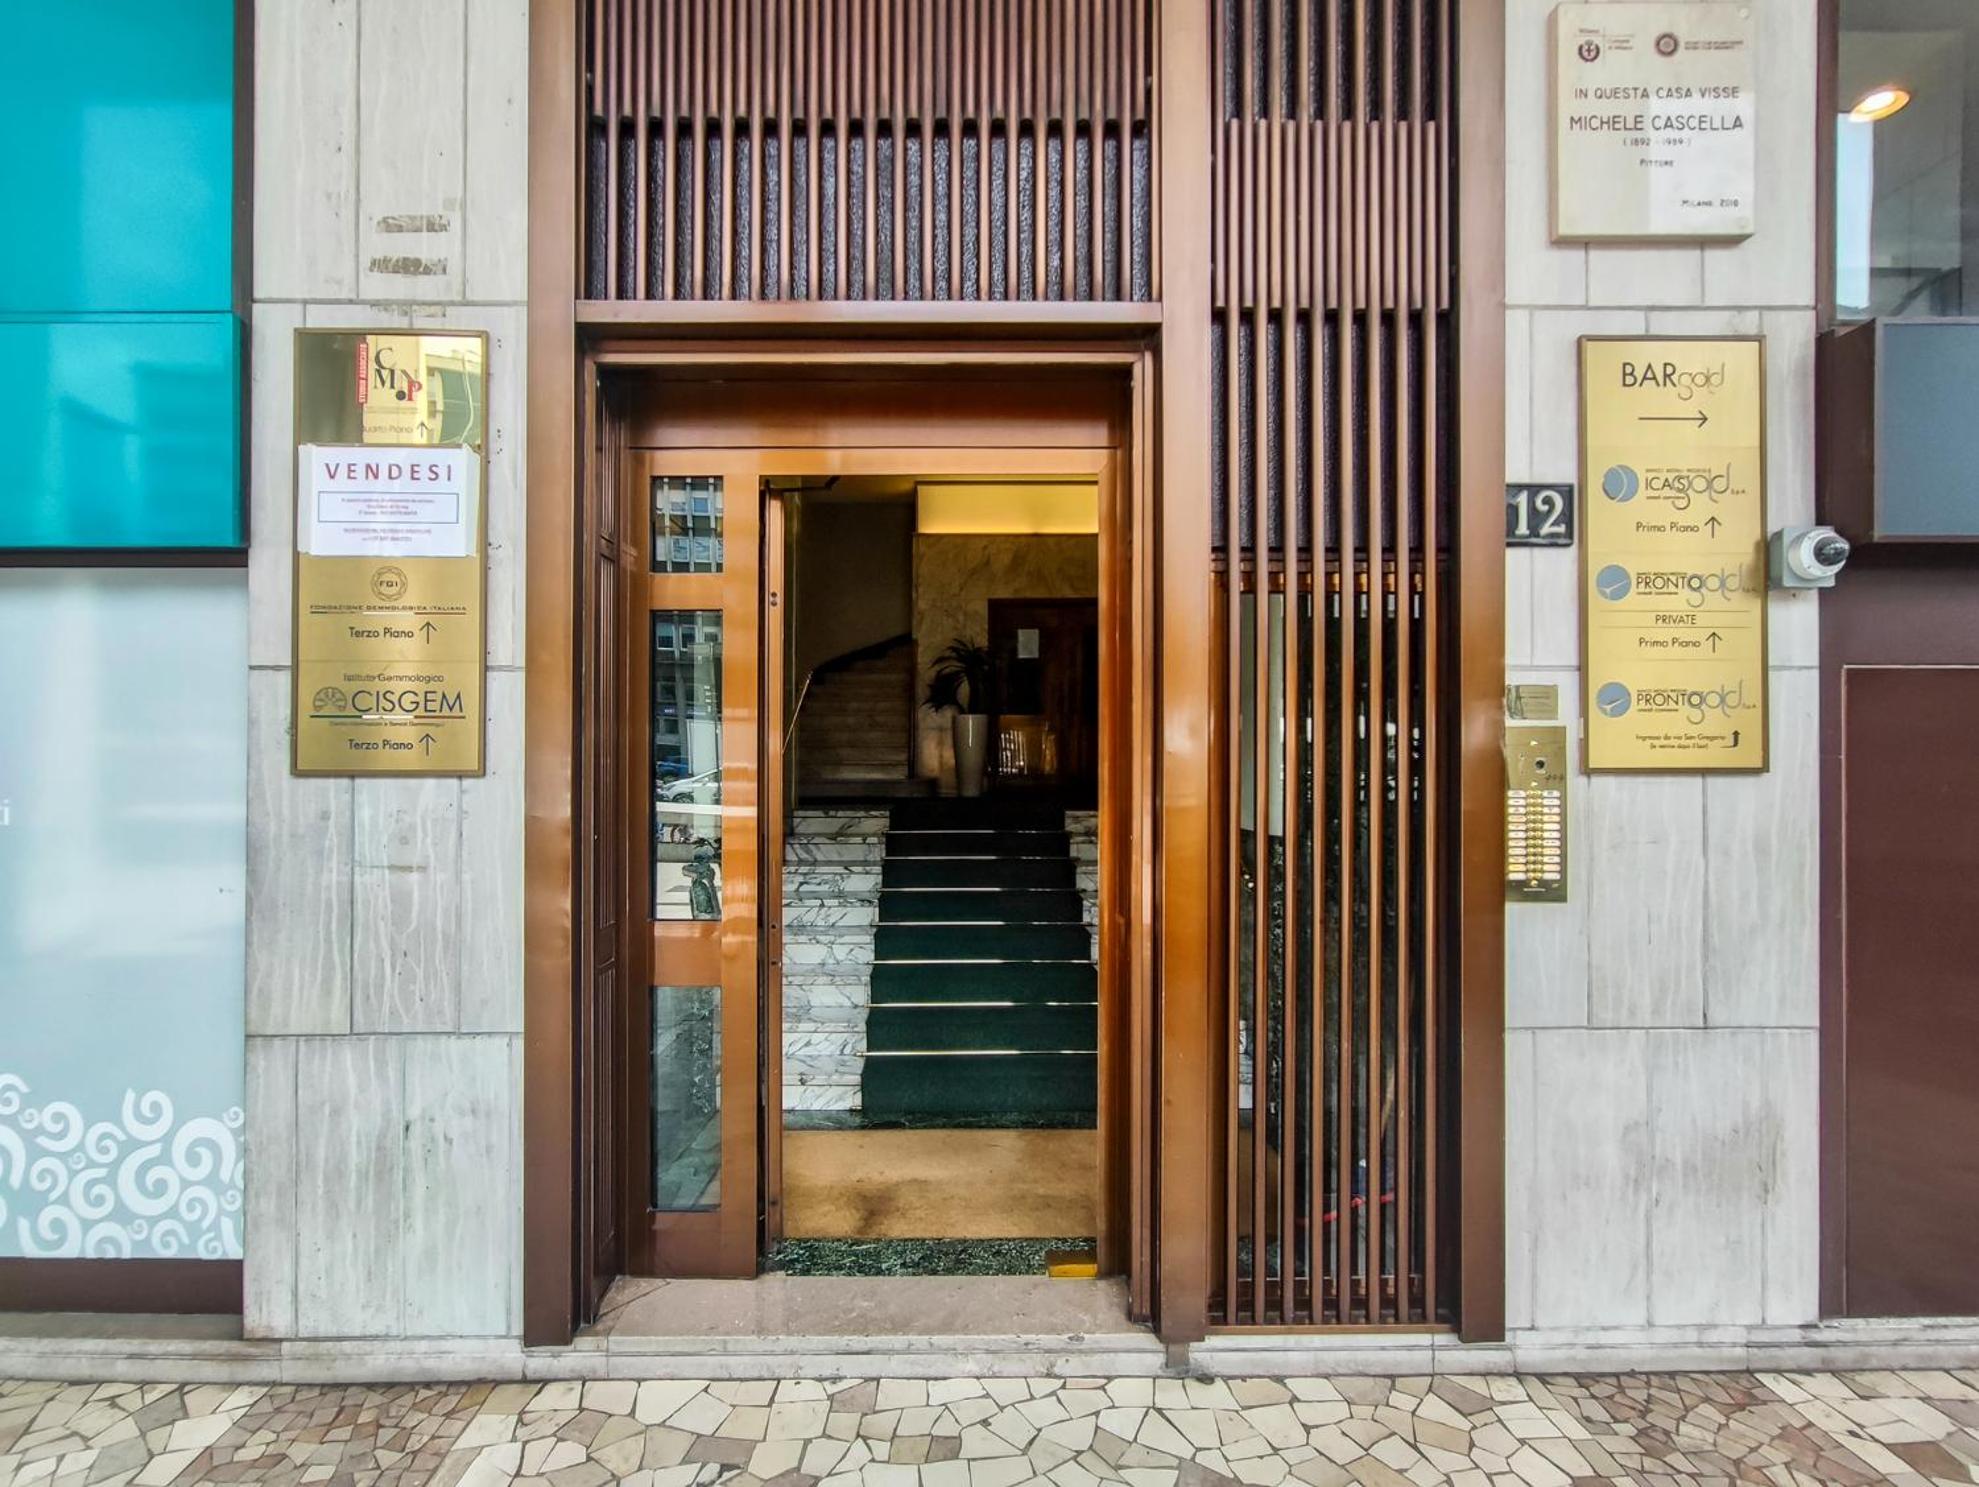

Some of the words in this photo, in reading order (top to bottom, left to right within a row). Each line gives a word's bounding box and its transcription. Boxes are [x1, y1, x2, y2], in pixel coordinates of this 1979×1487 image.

[1574, 87, 1588, 99] IN
[1594, 86, 1650, 99] QUESTA
[1656, 86, 1693, 99] CASA
[1699, 86, 1740, 99] VISSE
[1569, 115, 1645, 131] MICHELE
[1651, 115, 1744, 131] CASCELLA
[324, 462, 452, 482] VENDESI
[1507, 489, 1566, 537] 12
[1635, 521, 1666, 533] Primo
[1669, 521, 1700, 533] Piano
[1654, 614, 1697, 625] PRIVATE
[348, 626, 380, 639] Terzo
[383, 626, 415, 639] Piano
[1638, 636, 1669, 648] Primo
[1671, 637, 1701, 649] Piano
[343, 673, 377, 683] Istituto
[378, 673, 445, 684] Gemmologico
[351, 689, 464, 713] CISGEM
[348, 738, 379, 750] Terzo
[382, 738, 414, 751] Piano
